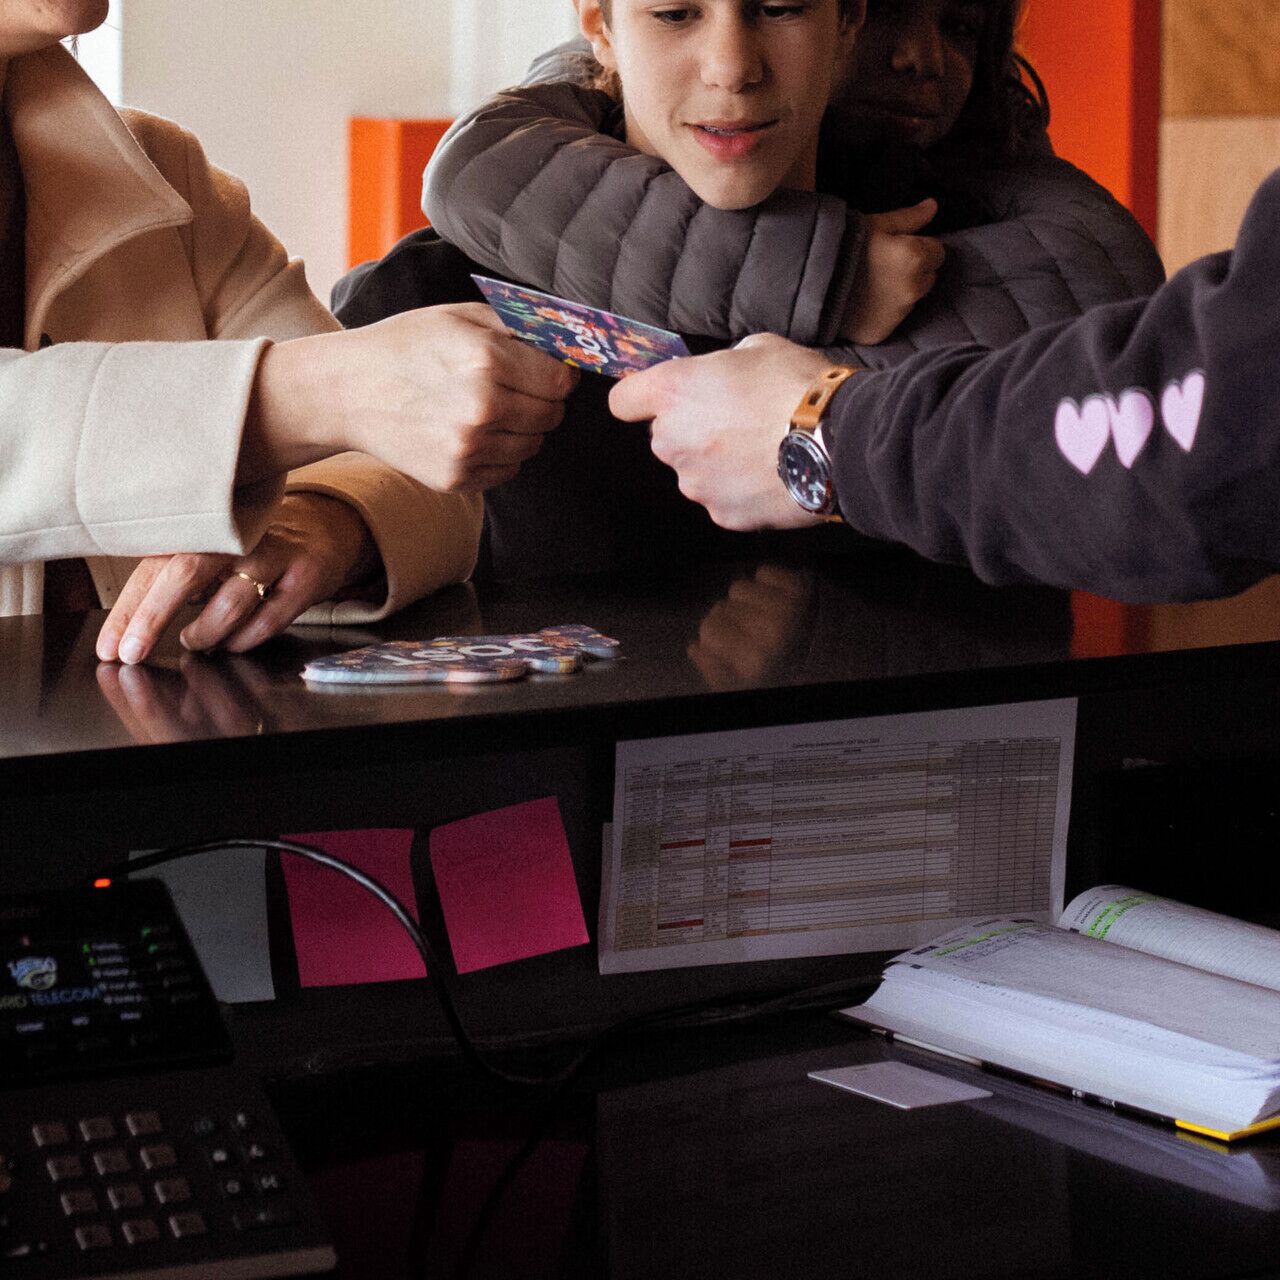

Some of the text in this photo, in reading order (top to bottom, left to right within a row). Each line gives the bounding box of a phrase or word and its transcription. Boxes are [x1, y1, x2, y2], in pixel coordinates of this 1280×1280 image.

[558, 310, 609, 364] JOST
[380, 638, 553, 667] JOST
[30, 984, 102, 1008] TELECOM
